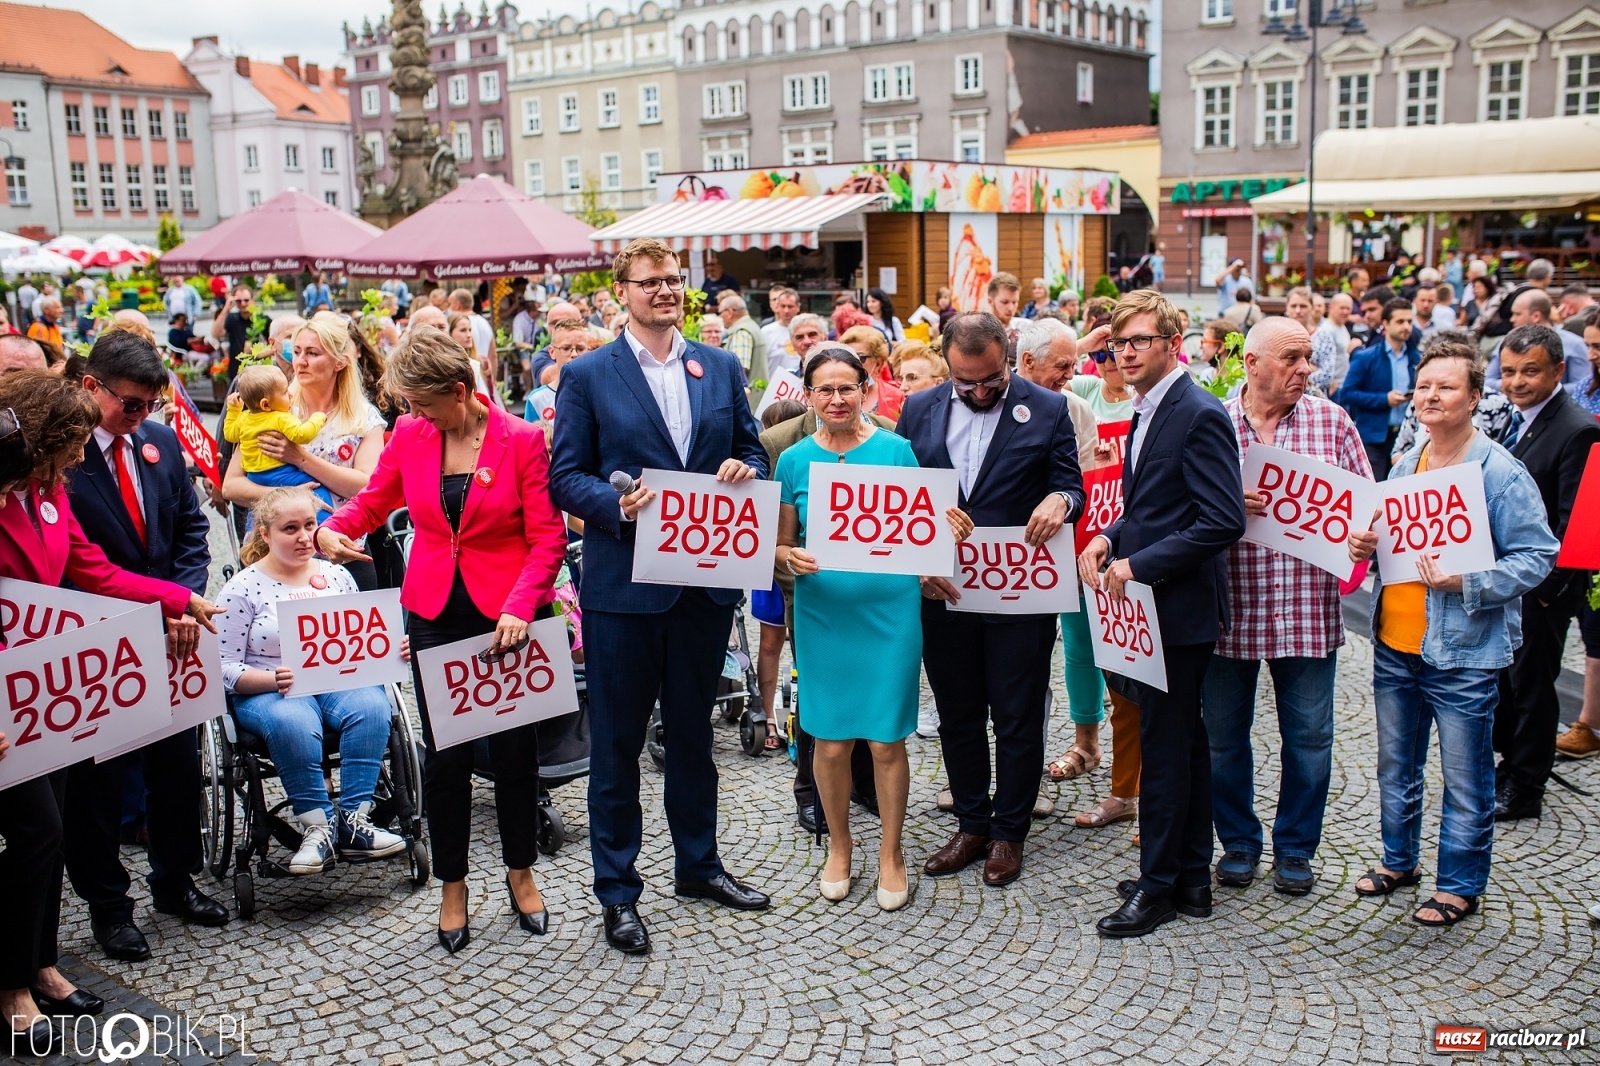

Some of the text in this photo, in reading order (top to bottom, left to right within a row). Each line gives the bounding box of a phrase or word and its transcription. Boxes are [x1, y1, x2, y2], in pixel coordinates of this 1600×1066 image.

[1171, 177, 1306, 203] APTEK
[210, 261, 249, 274] Gelateria
[251, 260, 271, 271] Ciao
[272, 258, 299, 270] Italia
[434, 259, 539, 278] Gelateria Ciao Italia
[587, 254, 603, 267] Ciao
[181, 405, 212, 455] DUDA
[181, 427, 213, 468] 2020
[660, 489, 759, 528] DUDA
[830, 482, 935, 516] DUDA
[1090, 479, 1124, 508] DUD
[1257, 463, 1352, 520] DUDA
[1385, 484, 1468, 526] DUDA
[829, 512, 936, 546] 2020
[1085, 502, 1125, 532] 202
[1254, 490, 1348, 543] 2020
[1390, 513, 1472, 554] 2020
[657, 521, 759, 559] 2020
[957, 542, 1056, 567] DUDA
[961, 566, 1058, 590] 2020
[0, 598, 108, 640] DUD
[297, 606, 387, 641] DUDA
[1095, 589, 1150, 629] DUDA
[301, 633, 390, 668] 2020
[1101, 617, 1153, 657] 2020
[6, 636, 143, 711] DUDA
[443, 638, 551, 690] DUDA
[168, 671, 207, 707] 20
[450, 665, 555, 716] 2020
[13, 671, 147, 747] 2020
